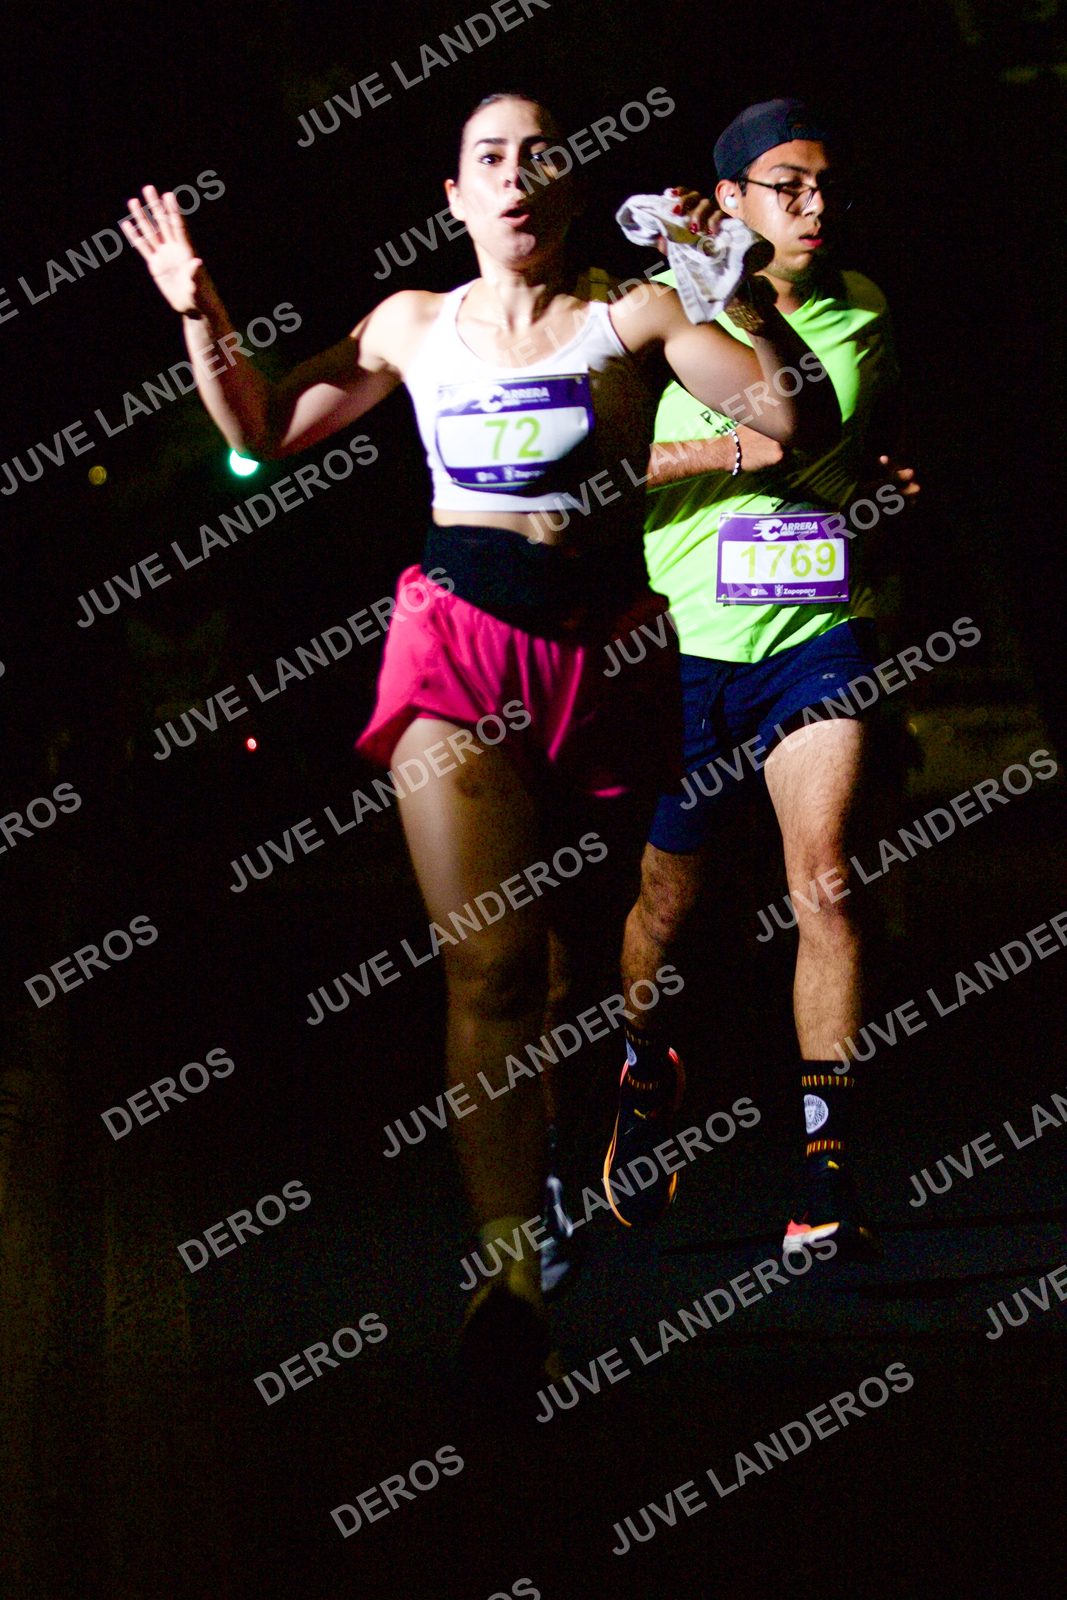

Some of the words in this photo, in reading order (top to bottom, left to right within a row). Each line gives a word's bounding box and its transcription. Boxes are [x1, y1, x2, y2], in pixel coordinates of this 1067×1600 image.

[484, 416, 544, 460] 72
[753, 518, 818, 541] CARRERA
[740, 541, 837, 579] 1769
